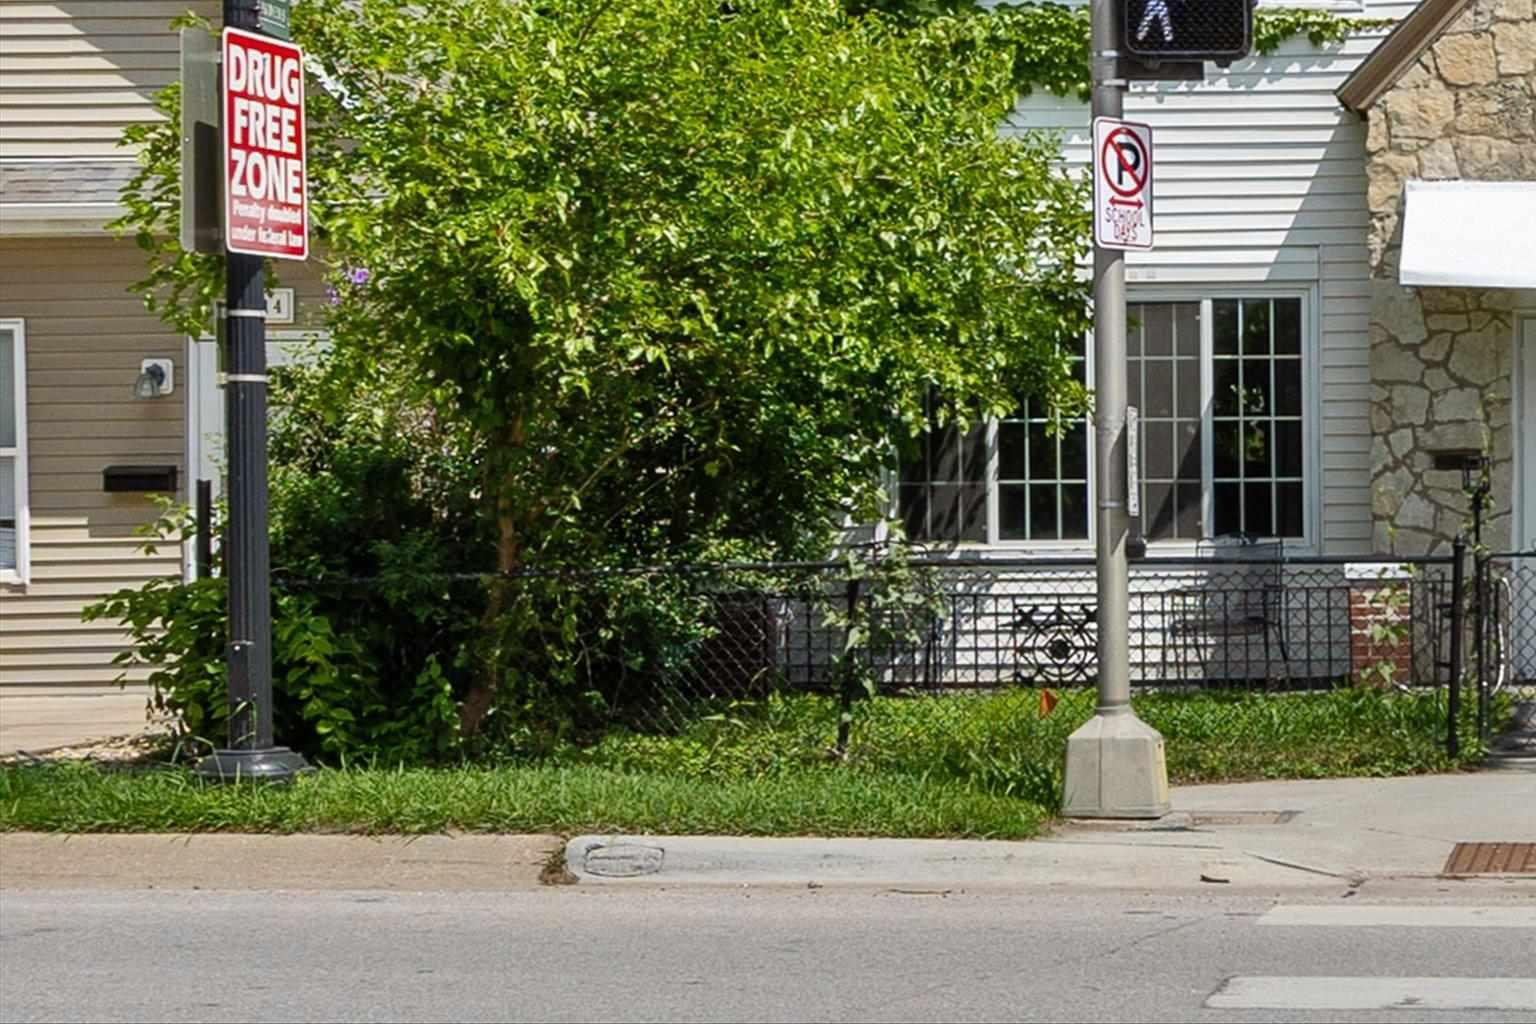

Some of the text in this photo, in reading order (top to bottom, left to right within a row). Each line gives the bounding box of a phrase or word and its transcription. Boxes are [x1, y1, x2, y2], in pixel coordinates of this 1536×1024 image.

[228, 43, 300, 106] DRUG
[233, 96, 297, 154] FREE
[231, 148, 302, 205] ZONE
